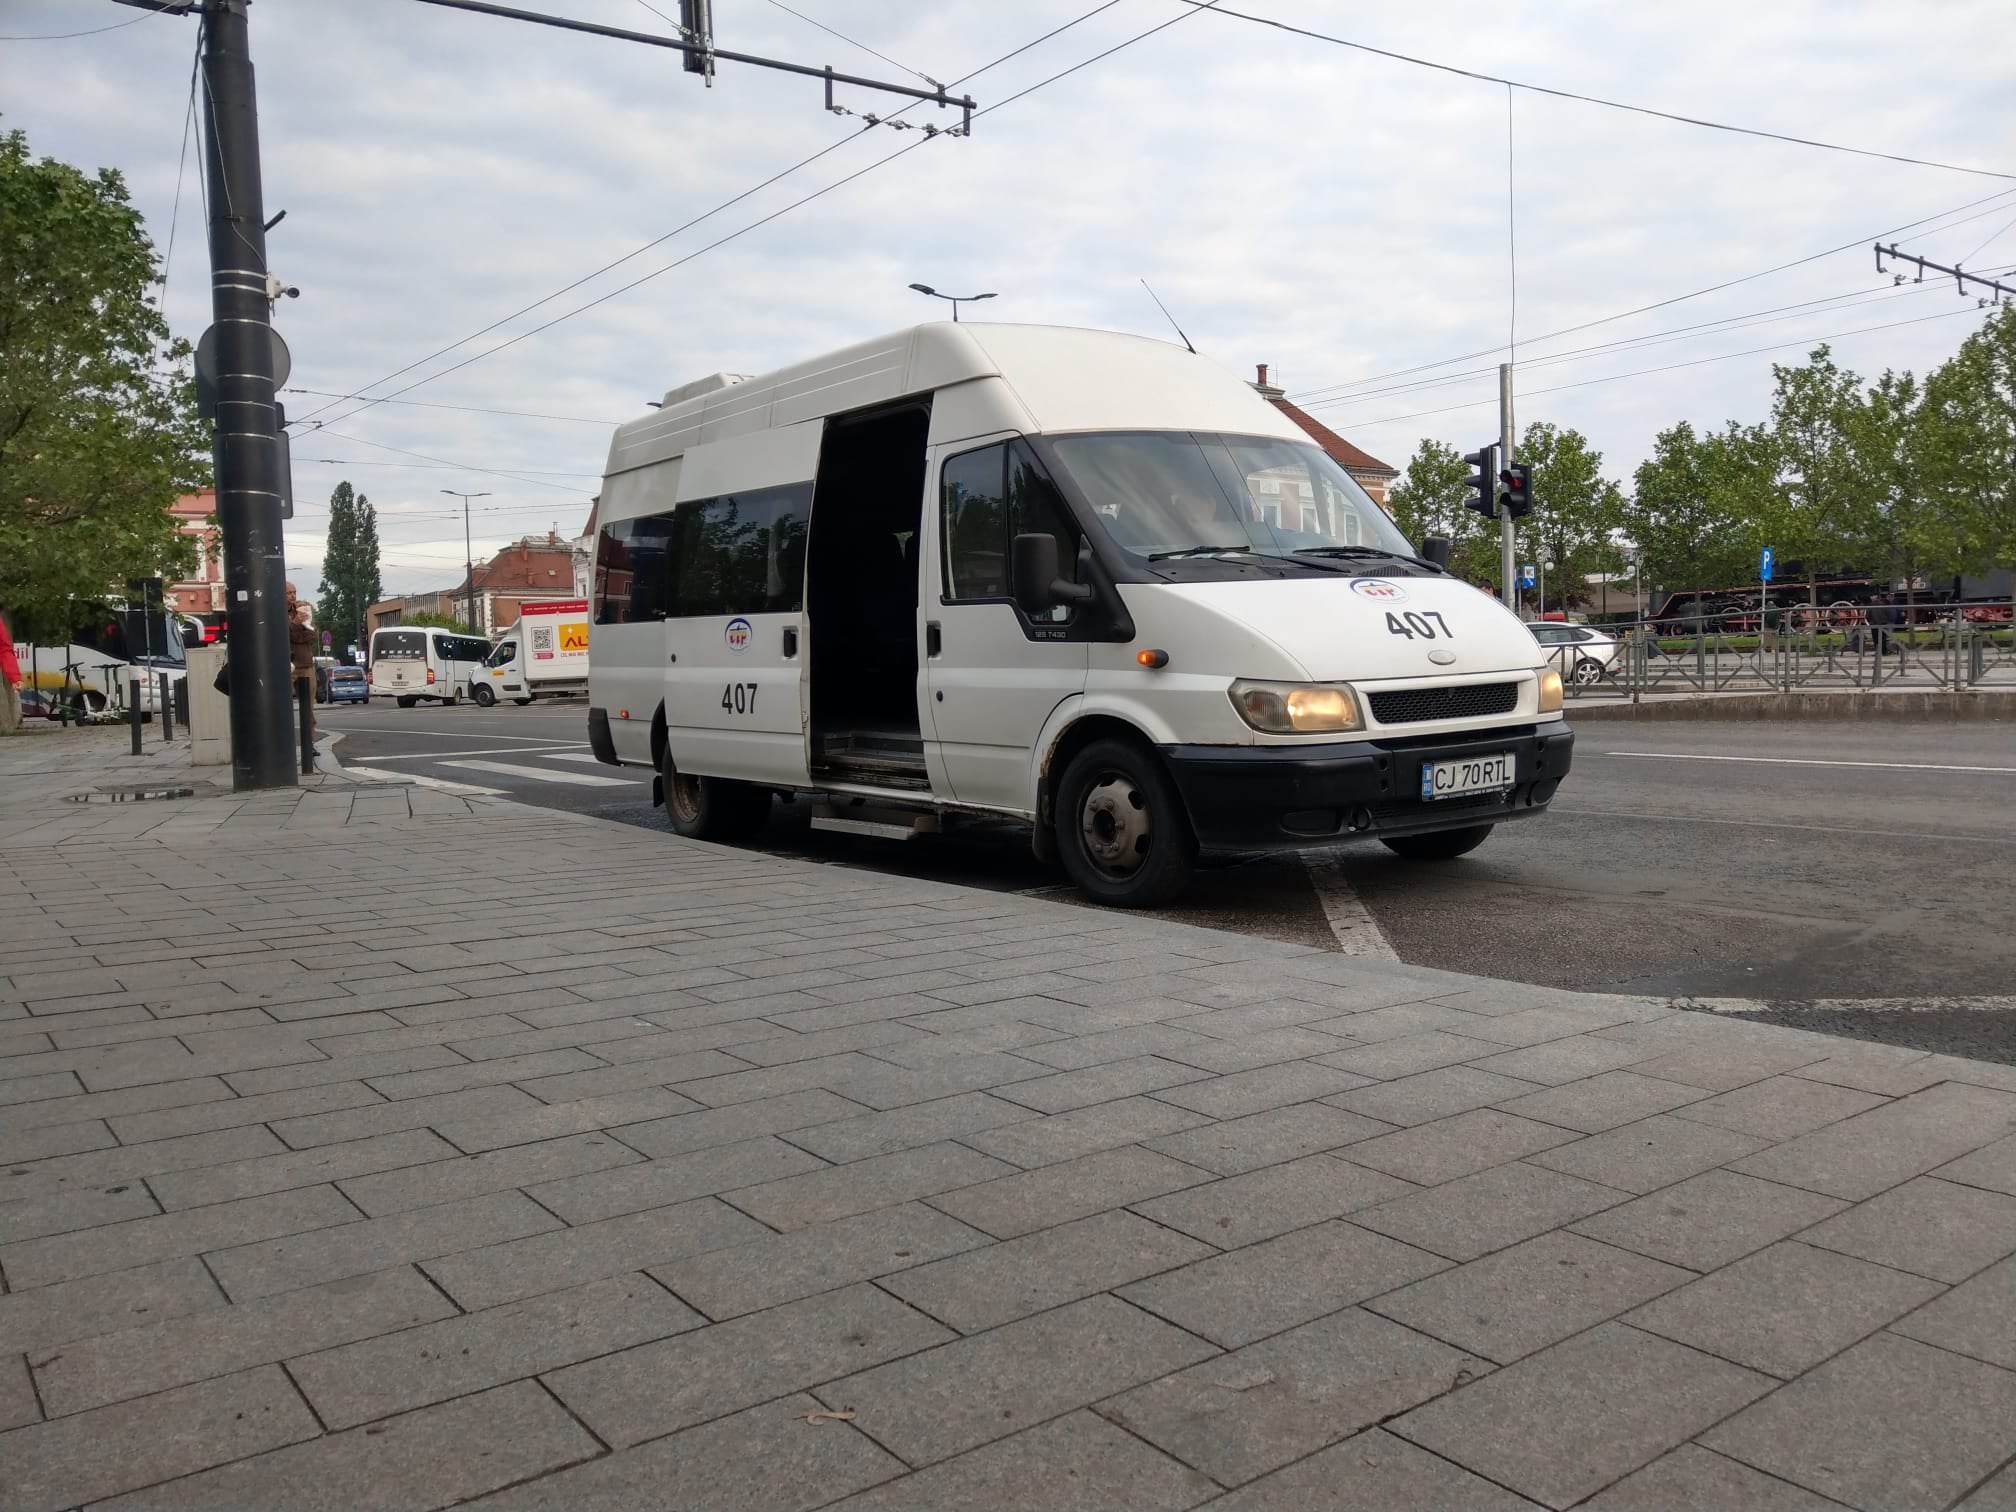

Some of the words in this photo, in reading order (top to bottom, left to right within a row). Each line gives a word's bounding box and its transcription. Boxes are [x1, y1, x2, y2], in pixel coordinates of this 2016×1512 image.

[1763, 551, 1770, 570] P
[1385, 611, 1454, 639] 407
[564, 634, 589, 648] AL
[721, 683, 758, 714] 407
[1435, 765, 1456, 790] CJ
